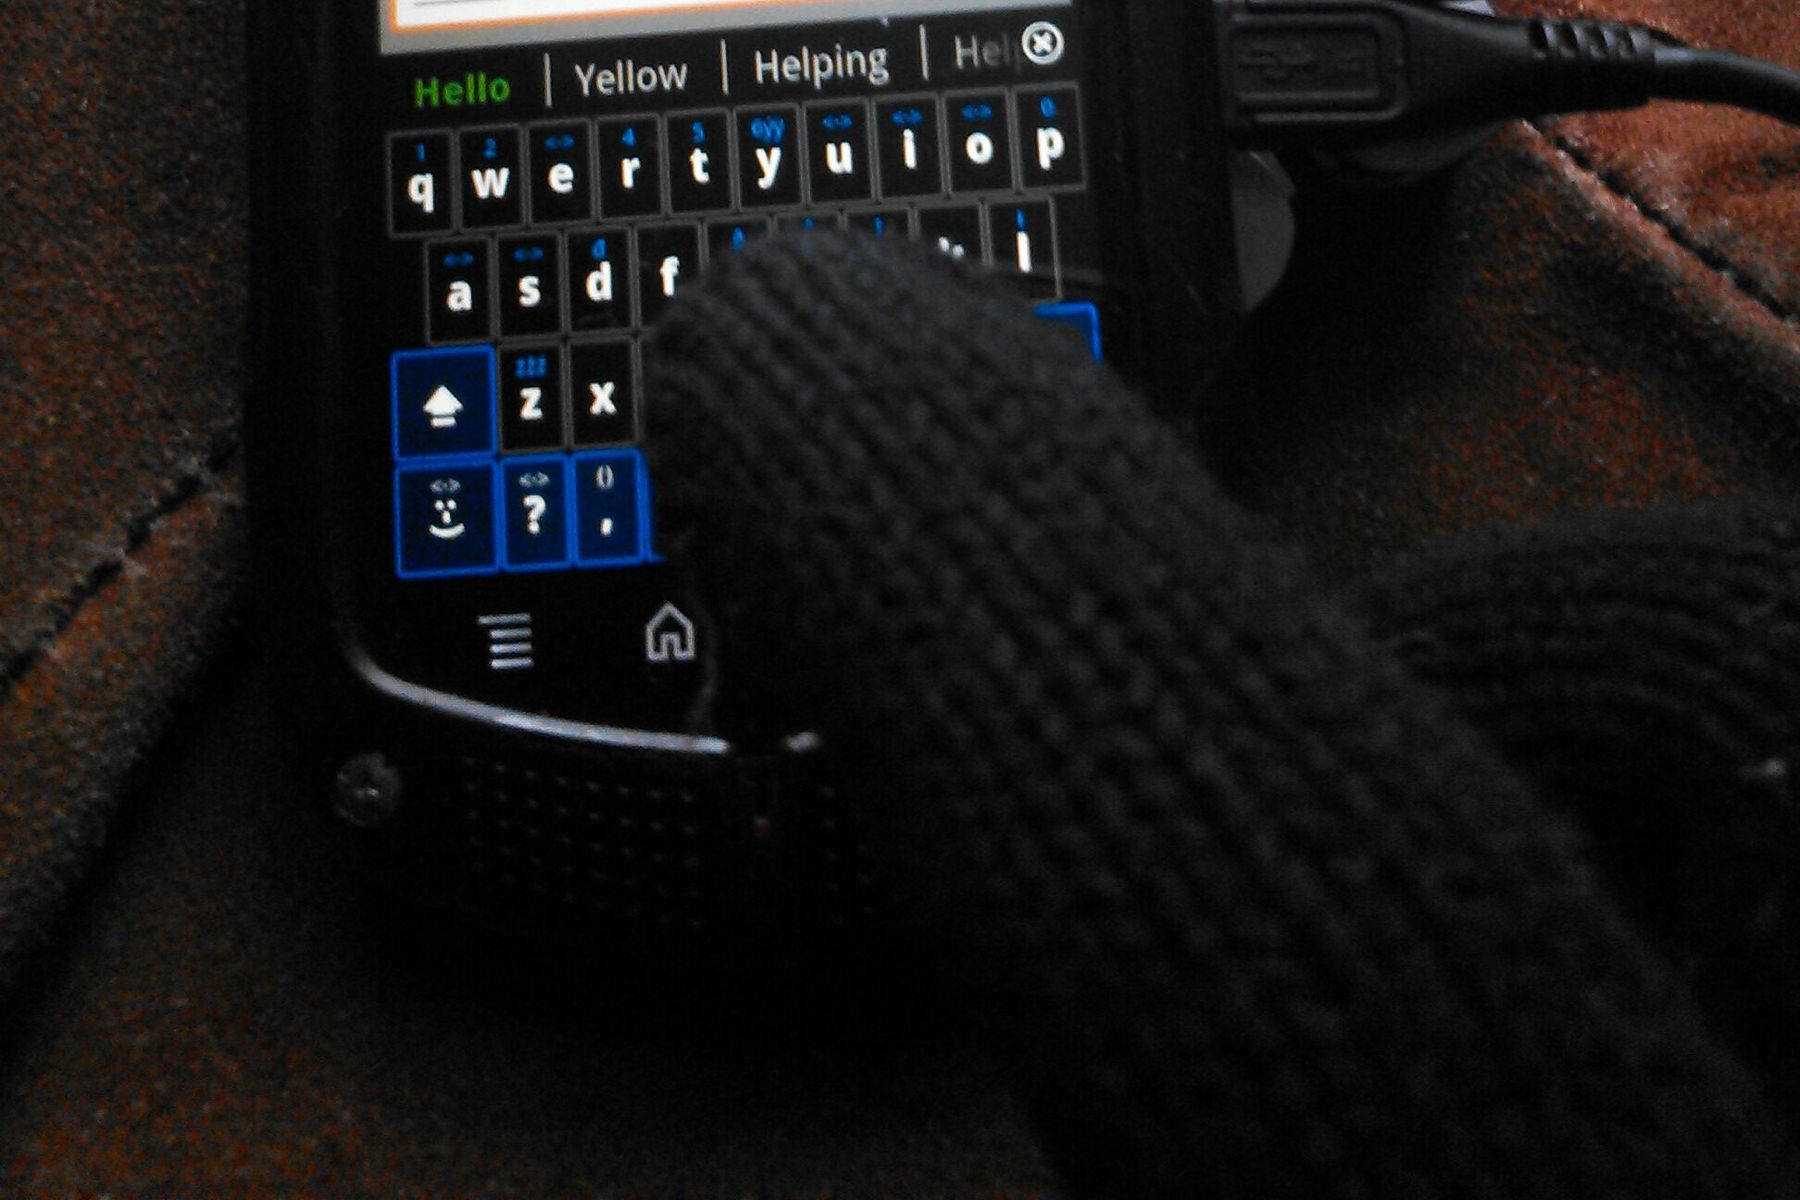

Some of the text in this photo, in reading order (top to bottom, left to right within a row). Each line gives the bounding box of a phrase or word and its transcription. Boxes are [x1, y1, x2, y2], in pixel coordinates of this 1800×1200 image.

[414, 71, 511, 108] Hello
[574, 59, 688, 97] Yellow
[753, 43, 890, 91] Helping
[407, 125, 1066, 214] q w e r t y u i o p
[446, 279, 473, 313] a
[518, 274, 542, 308] s
[585, 259, 614, 302] d
[659, 255, 682, 297] f
[519, 381, 618, 422] z x
